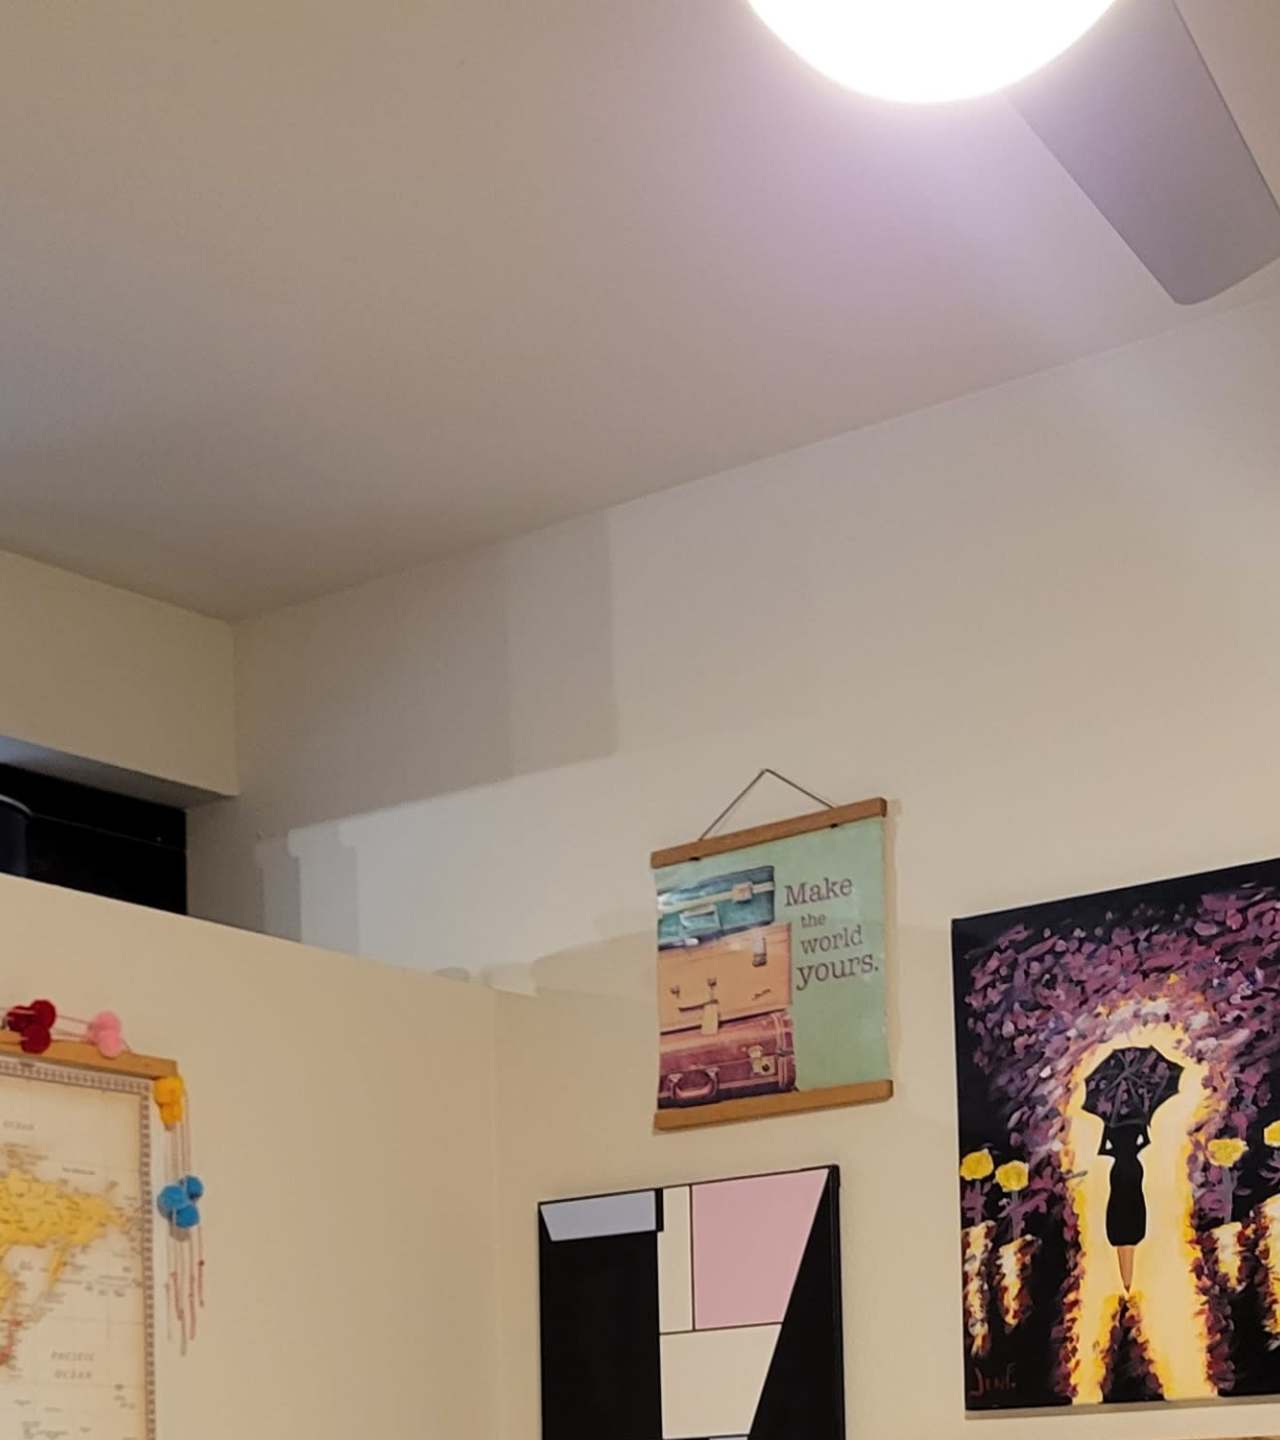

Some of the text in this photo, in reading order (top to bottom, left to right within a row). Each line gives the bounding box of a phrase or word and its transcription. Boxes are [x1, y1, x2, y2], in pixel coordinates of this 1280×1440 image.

[784, 876, 853, 907] Make
[800, 913, 826, 928] the
[801, 925, 863, 954] world
[796, 954, 879, 991] yours.
